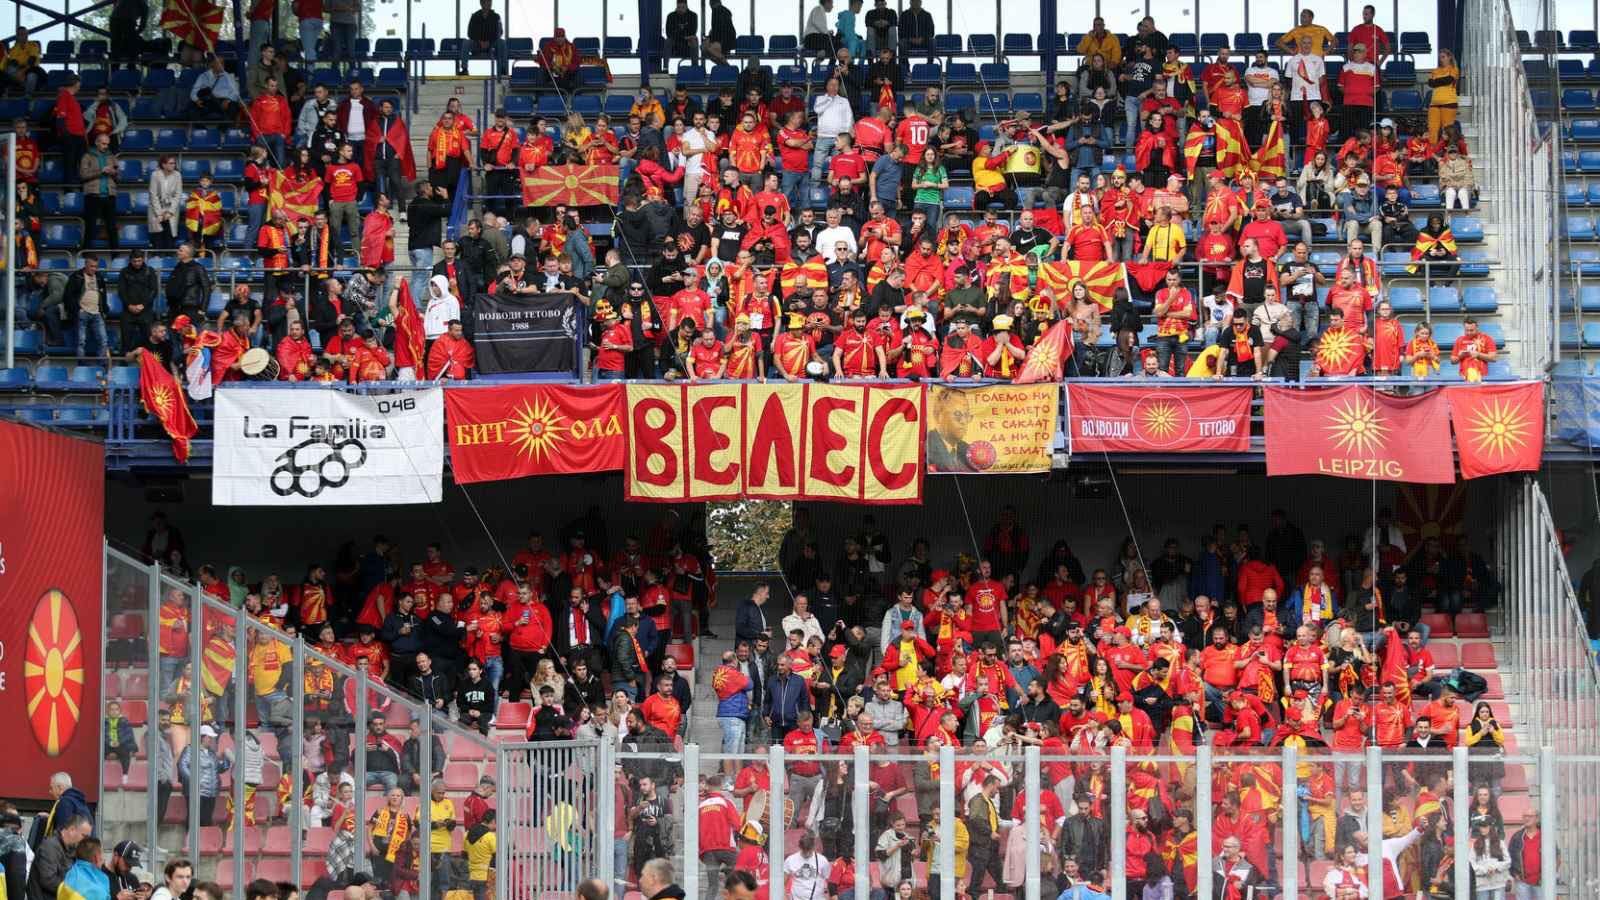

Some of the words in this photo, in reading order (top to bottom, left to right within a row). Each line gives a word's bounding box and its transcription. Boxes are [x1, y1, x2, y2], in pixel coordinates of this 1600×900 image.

[911, 126, 928, 145] 10
[479, 312, 521, 321] ВОЈВОДИ
[525, 309, 560, 318] ТЕТОВО
[511, 322, 529, 331] 1988
[975, 392, 1028, 403] ГОЛЕМО
[1032, 392, 1050, 400] НИ
[992, 407, 999, 416] Е
[1004, 405, 1050, 417] ИМЕТО
[243, 416, 277, 438] La
[289, 416, 386, 440] Familia
[455, 421, 507, 446] БИТ
[570, 415, 623, 440] ОЛА
[1081, 420, 1129, 438] ВОЈВОДИ
[1199, 419, 1236, 436] ТЕТОВО
[633, 391, 918, 490] ВЕЛЕС
[1318, 457, 1403, 477] LEIPZIG
